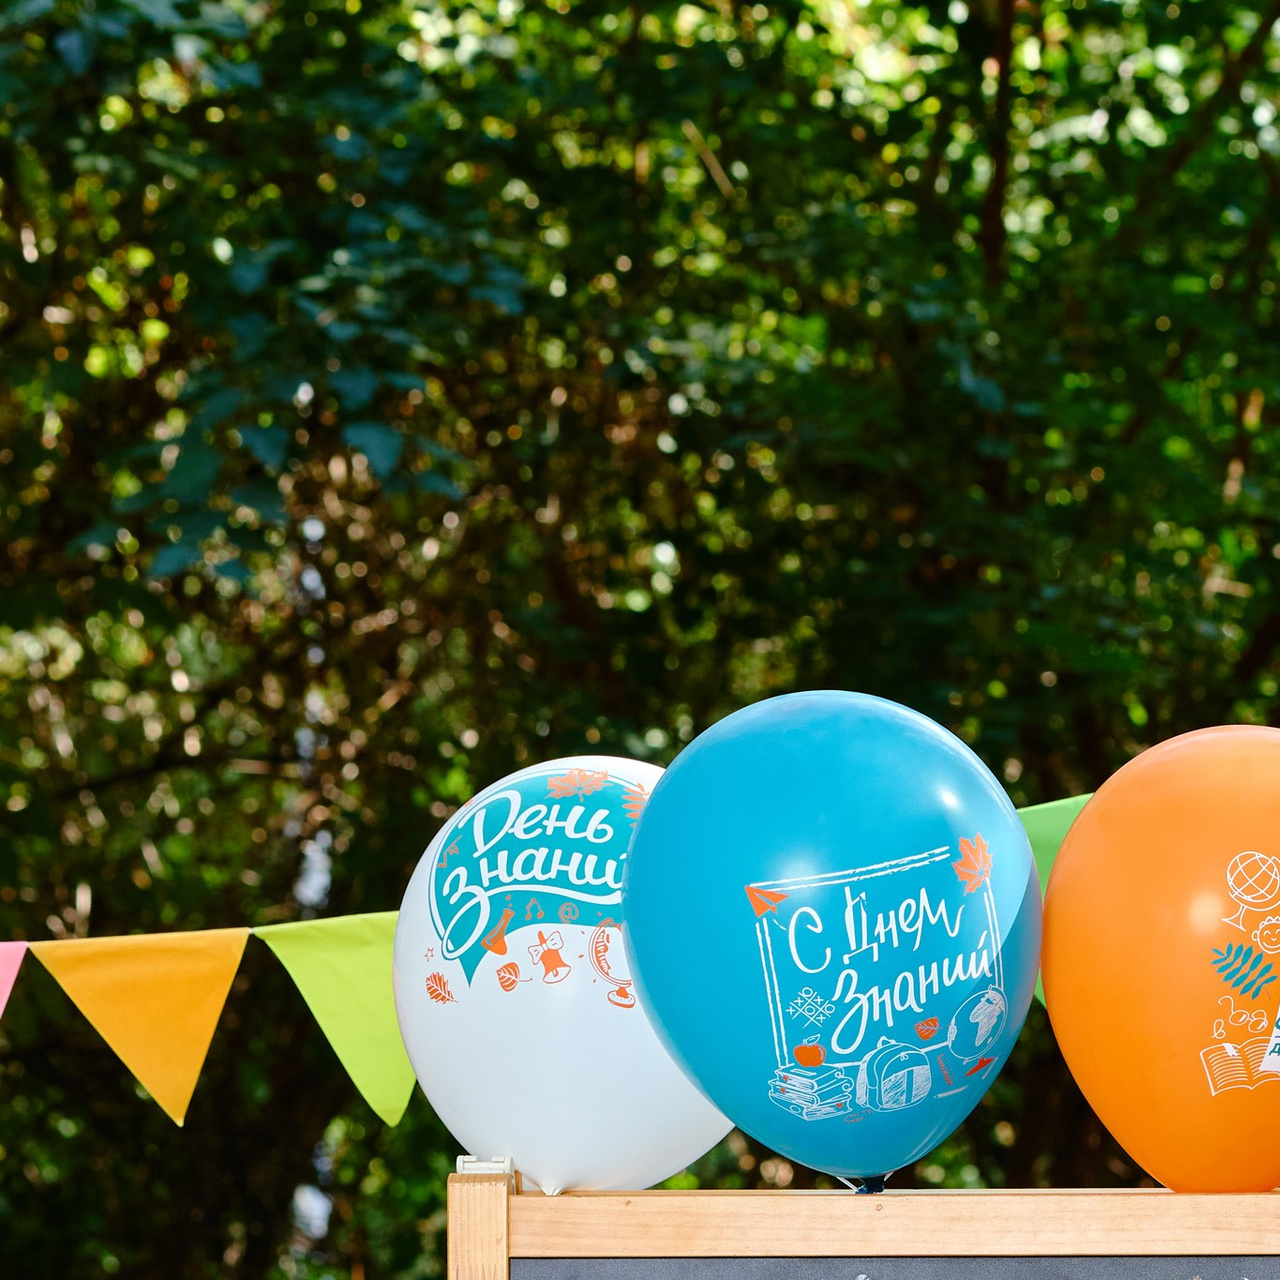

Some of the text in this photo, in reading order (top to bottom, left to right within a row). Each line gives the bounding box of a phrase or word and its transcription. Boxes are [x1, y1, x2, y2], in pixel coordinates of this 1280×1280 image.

[458, 789, 614, 859] День
[441, 847, 627, 961] Знани
[788, 885, 966, 974] С Днем
[830, 930, 993, 1055] Знаний
